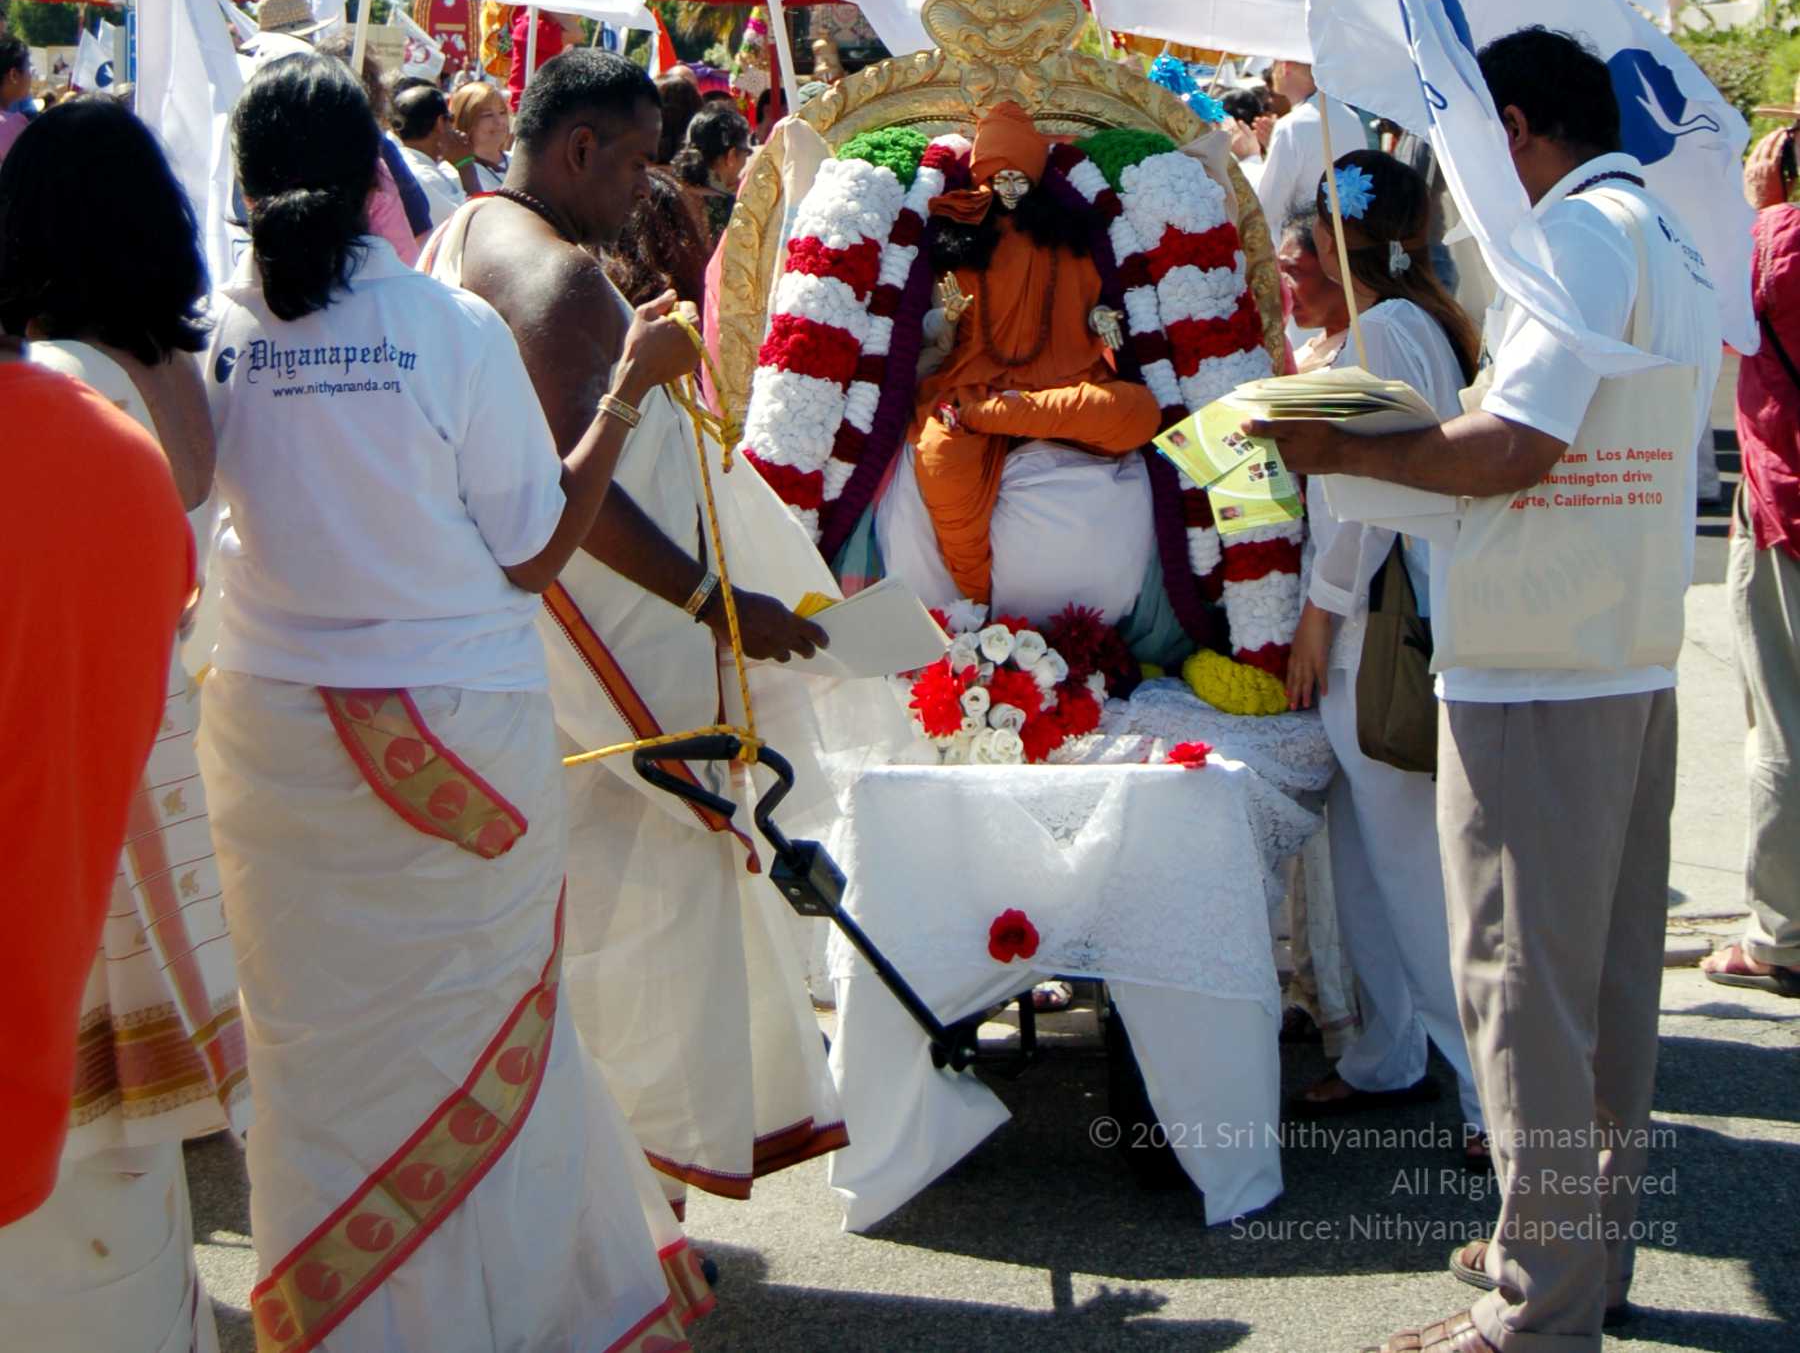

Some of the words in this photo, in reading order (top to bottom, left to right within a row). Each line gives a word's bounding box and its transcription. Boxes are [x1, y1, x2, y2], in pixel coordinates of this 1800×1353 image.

[246, 336, 417, 384] Dhyanapeetam
[1596, 449, 1622, 462] Los
[1626, 447, 1674, 463] Angeles
[1553, 492, 1624, 507] California
